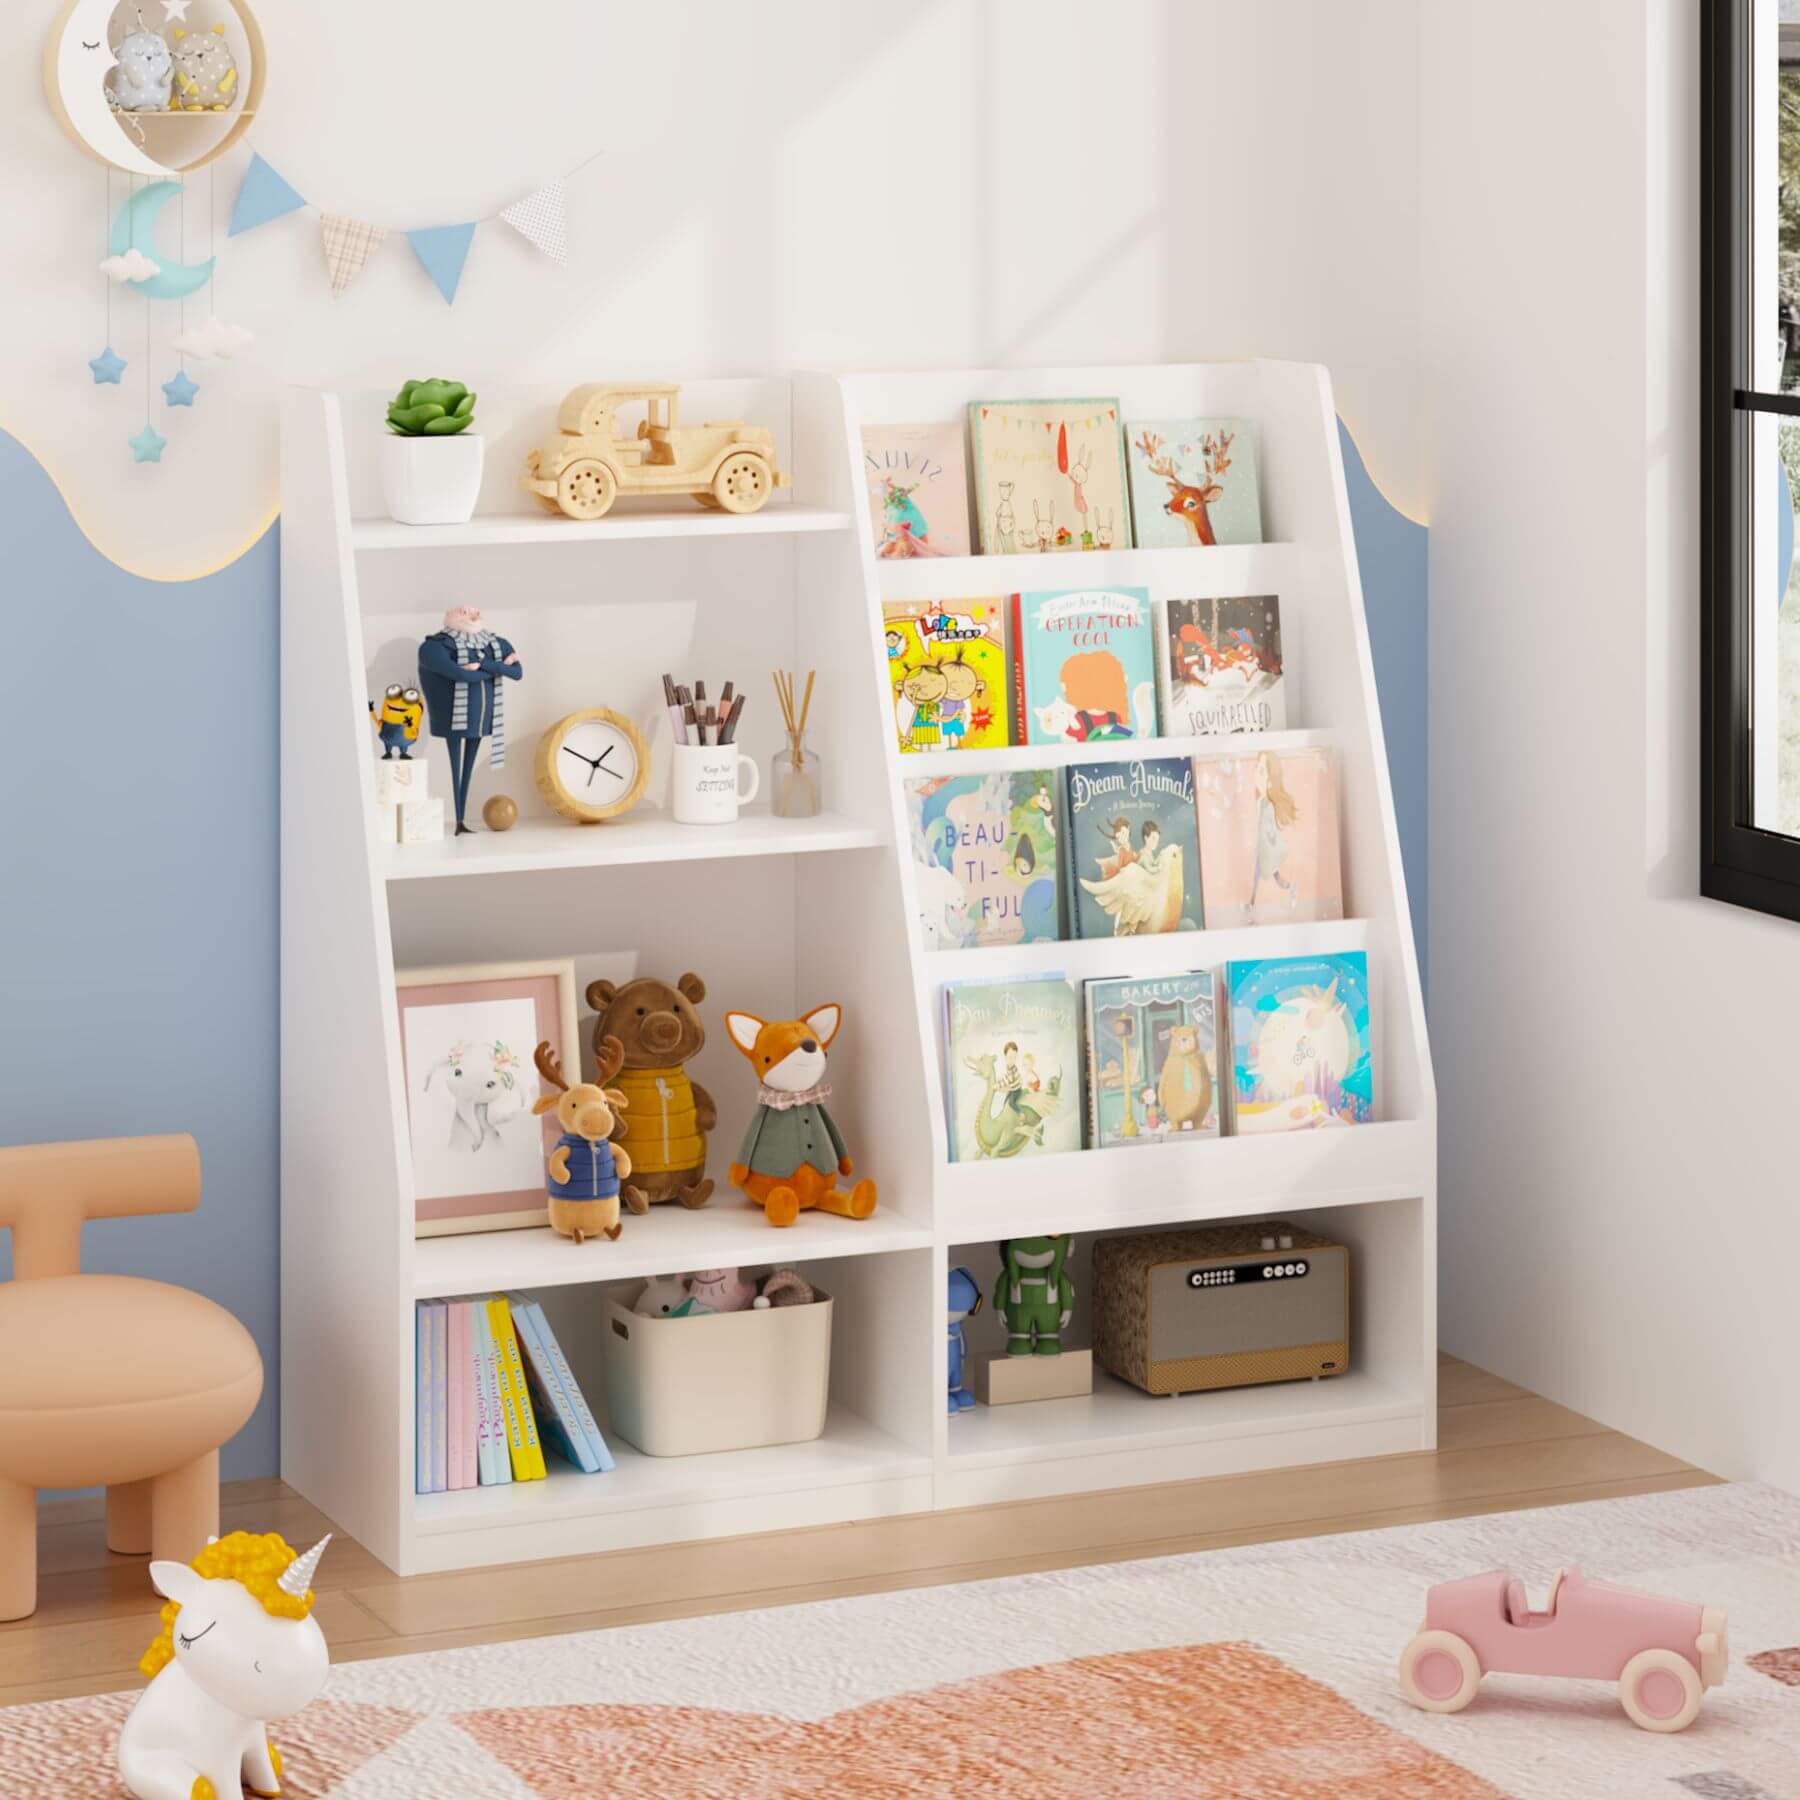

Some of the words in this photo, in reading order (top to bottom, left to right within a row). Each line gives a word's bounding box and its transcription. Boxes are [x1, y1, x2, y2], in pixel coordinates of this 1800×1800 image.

[1071, 769, 1127, 814] Dream
[1129, 759, 1194, 805] Animals
[981, 895, 1022, 920] FUL
[1120, 981, 1181, 1000] BAKERY
